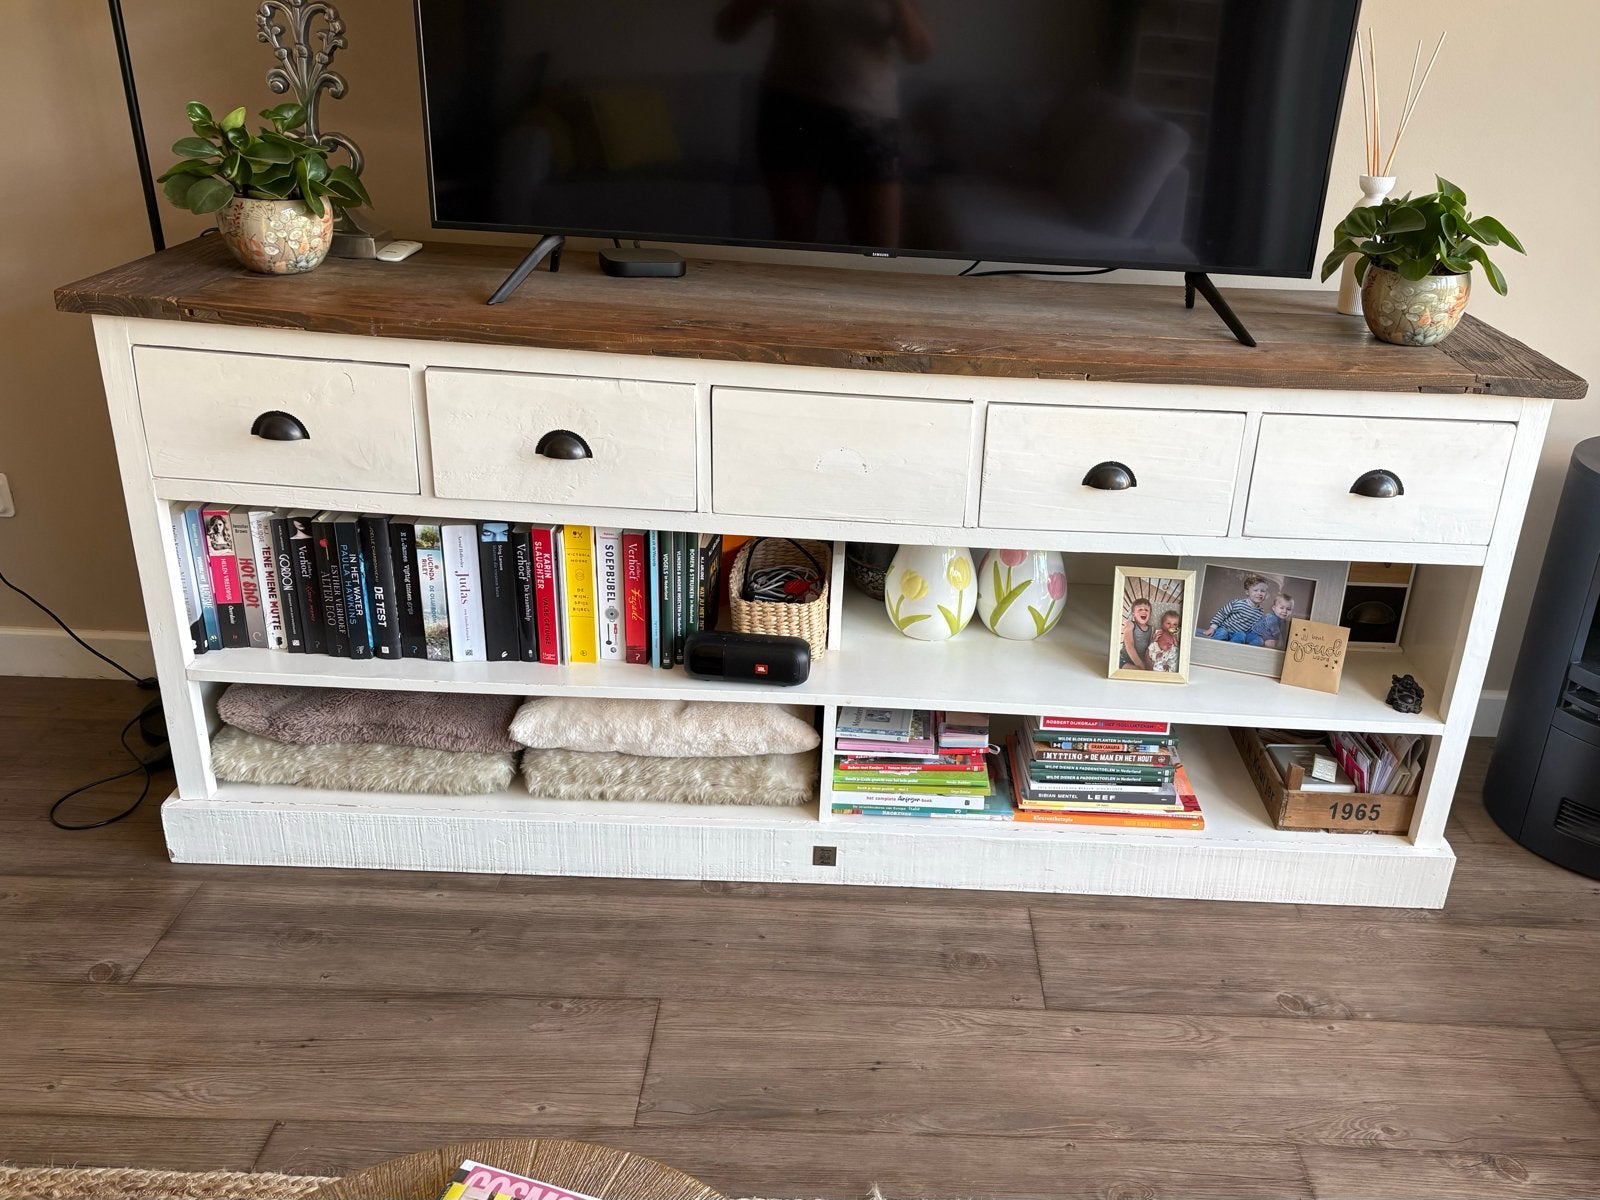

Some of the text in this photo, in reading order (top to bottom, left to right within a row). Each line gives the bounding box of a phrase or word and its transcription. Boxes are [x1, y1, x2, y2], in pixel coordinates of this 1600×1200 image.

[257, 520, 265, 543] ARLIDGE
[278, 554, 294, 591] GORDON
[298, 546, 310, 578] Verhoef
[402, 564, 411, 584] Vijftig
[426, 553, 434, 581] LUCINDA
[516, 543, 528, 582] Verhoef
[534, 541, 544, 589] SLAUGHTER
[544, 553, 552, 579] KARIN
[628, 543, 638, 582] Verhoef
[266, 570, 278, 600] MIENE
[321, 570, 336, 626] ALTER EGO
[330, 564, 346, 635] ESTHER VERHOEF
[340, 544, 357, 625] PAULA HAWKINS
[349, 554, 364, 616] IN HET WATER
[429, 584, 435, 592] DE
[454, 570, 470, 605] Judas
[270, 600, 282, 631] MUTTE
[374, 587, 387, 628] DE TEST
[524, 584, 532, 622] De kraamhulp
[630, 588, 644, 622] Façade
[1290, 638, 1342, 662] goud
[1046, 752, 1083, 760] MYTTING
[1329, 802, 1381, 821] 1965
[461, 1171, 574, 1200] COSM
